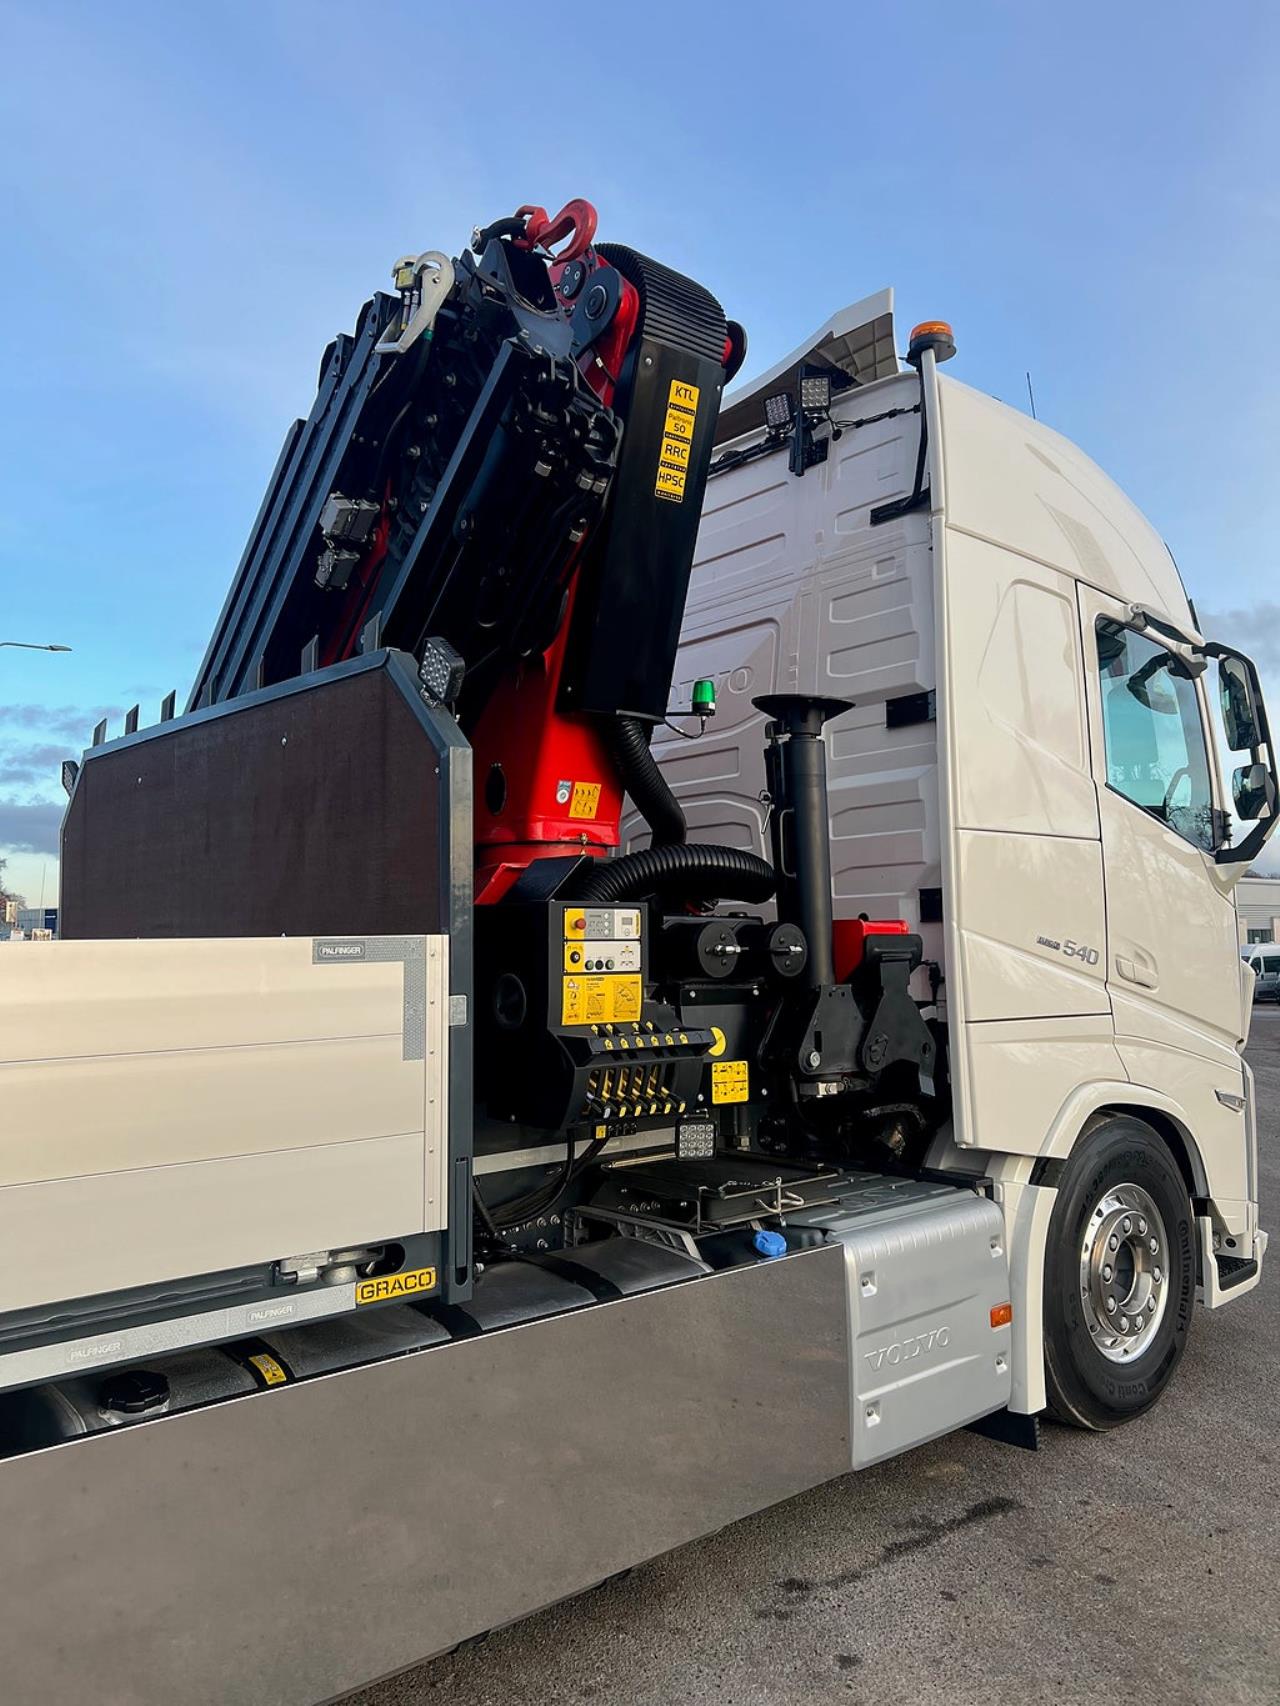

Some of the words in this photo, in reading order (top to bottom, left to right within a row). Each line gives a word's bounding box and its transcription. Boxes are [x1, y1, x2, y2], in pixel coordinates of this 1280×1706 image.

[675, 386, 694, 402] KTL
[674, 423, 686, 434] 50
[665, 444, 687, 460] RRC
[659, 471, 684, 488] HPSC
[321, 946, 361, 955] PALFINGER
[1063, 939, 1099, 965] 540
[360, 1271, 432, 1300] GRACO
[864, 1326, 950, 1372] VOLVO
